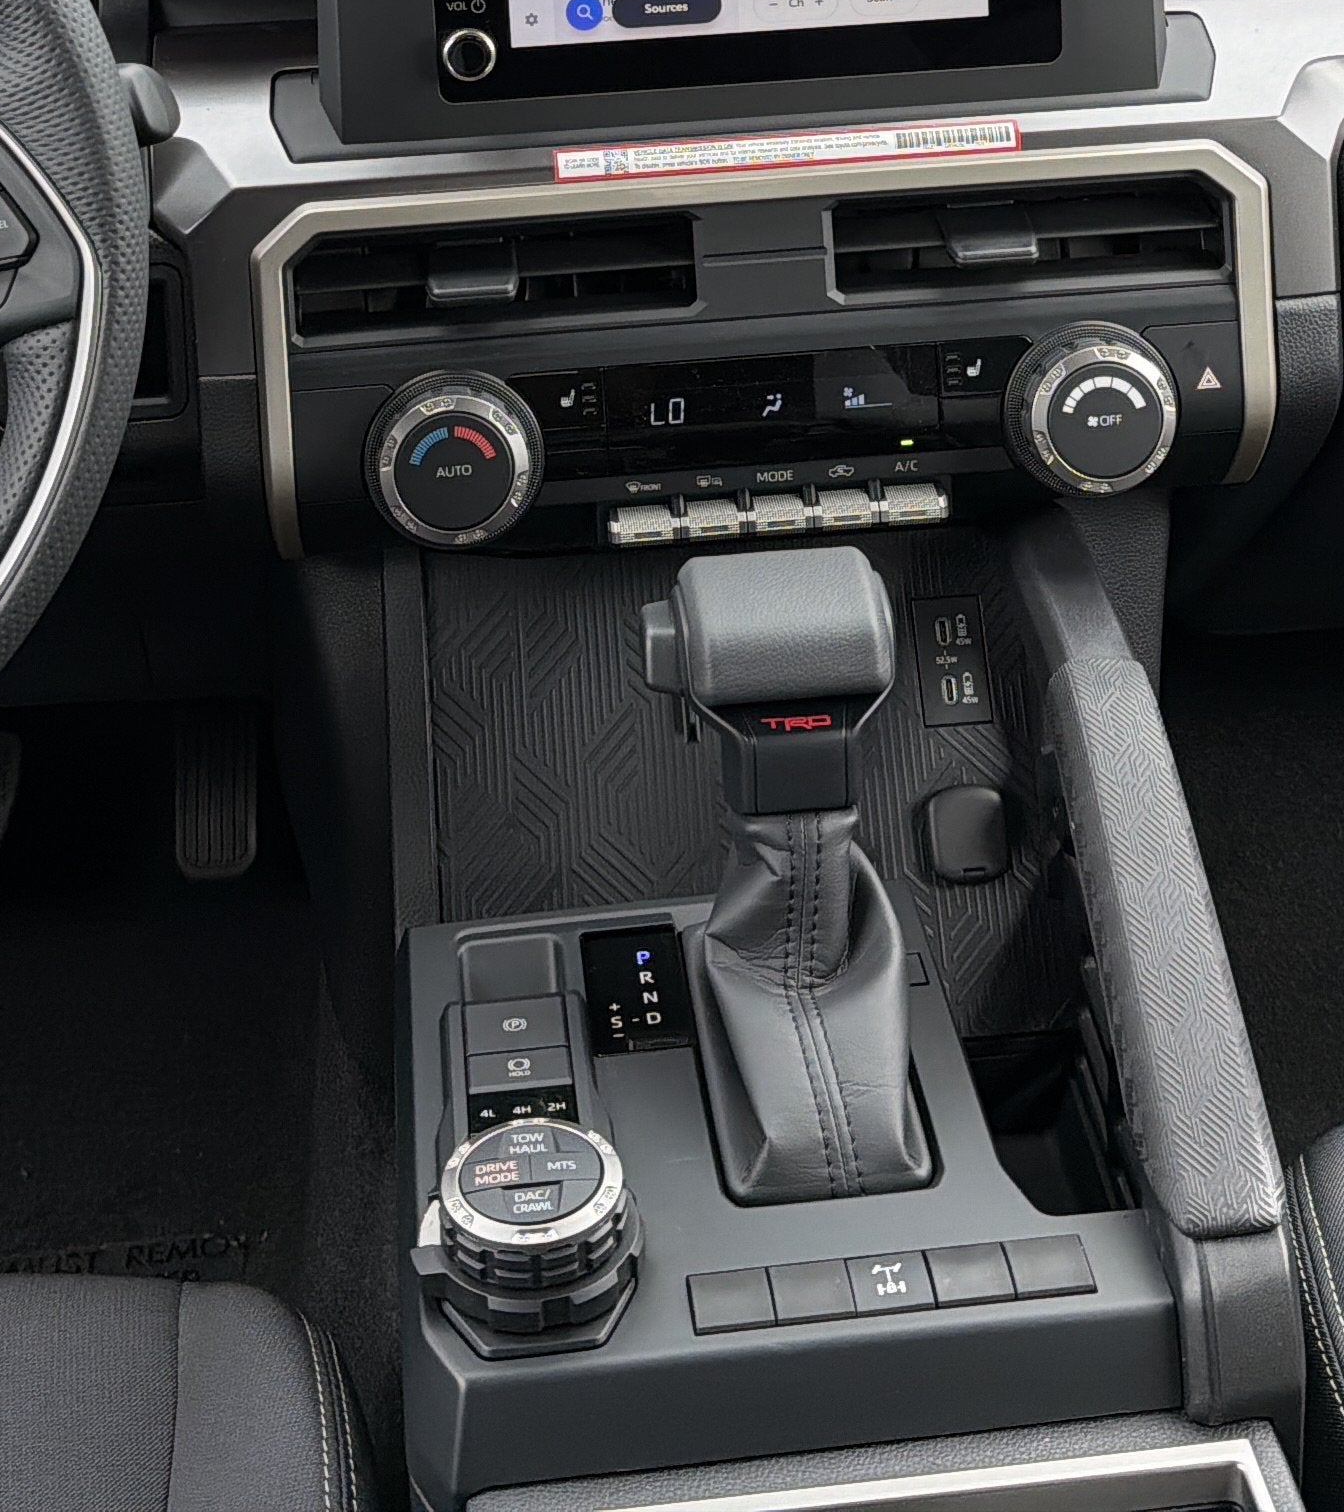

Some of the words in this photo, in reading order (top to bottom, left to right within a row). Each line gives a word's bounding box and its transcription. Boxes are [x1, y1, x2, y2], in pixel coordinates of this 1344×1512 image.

[446, 1, 468, 11] VOL
[644, 2, 689, 14] Sources
[1099, 414, 1123, 426] OFF
[435, 464, 472, 479] AUTO
[895, 458, 918, 473] A/C
[756, 469, 794, 483] MODE
[640, 481, 661, 491] FRONT
[936, 655, 958, 665] 52.5W
[962, 695, 978, 704] 45W
[761, 714, 832, 732] TRD
[636, 950, 651, 965] P
[639, 971, 654, 984] R
[643, 991, 659, 1003] N
[611, 1015, 623, 1029] S
[646, 1012, 662, 1025] D
[508, 1069, 531, 1077] HOLD
[479, 1109, 497, 1118] 4L
[512, 1105, 532, 1115] 4H
[547, 1101, 566, 1112] 2H
[511, 1132, 545, 1144] TOW
[509, 1143, 548, 1155] HAUL
[475, 1160, 519, 1175] DRIVE
[547, 1160, 577, 1171] MTS
[474, 1171, 520, 1186] MODE
[514, 1189, 550, 1202] DAC/
[513, 1201, 554, 1214] CRAWL
